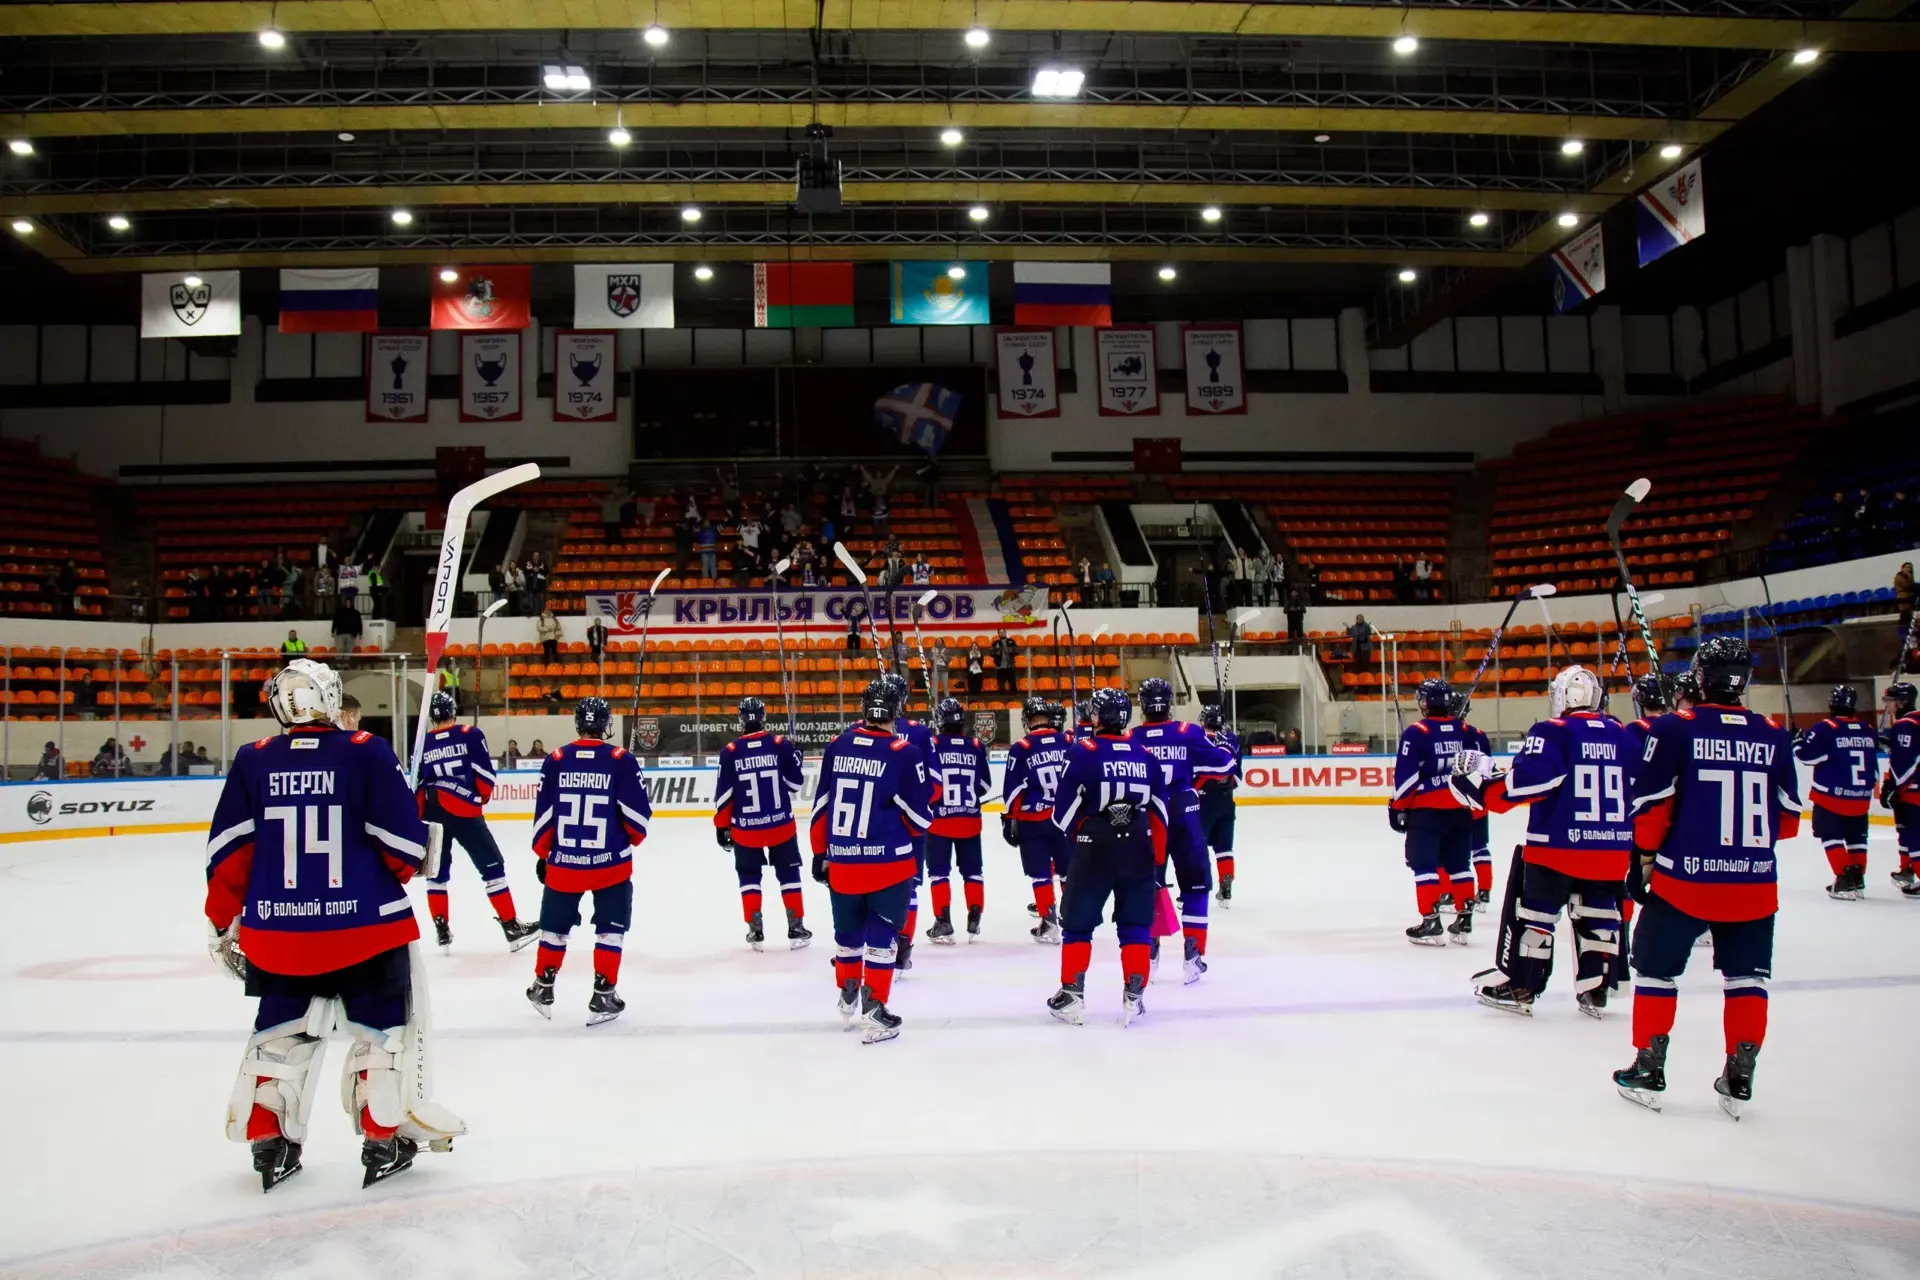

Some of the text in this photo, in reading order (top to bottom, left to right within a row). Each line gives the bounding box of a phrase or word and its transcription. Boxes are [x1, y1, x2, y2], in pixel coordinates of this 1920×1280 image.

[609, 275, 639, 286] МХЛ
[472, 391, 509, 403] 1957
[567, 391, 603, 403] 1974
[1011, 388, 1046, 400] 1974
[1110, 386, 1147, 398] 1977
[1197, 385, 1234, 397] 1989
[674, 595, 813, 624] КРЫЛЬЯ
[729, 722, 790, 733] ЧЕОНАТ
[423, 743, 469, 765] SHAMOLIN
[1524, 736, 1545, 755] 99
[1581, 742, 1617, 761] POPOV
[1642, 735, 1659, 763] 8
[1693, 737, 1776, 766] BUSLAYEV
[734, 754, 779, 772] PLATONOV
[832, 755, 887, 779] BURANOV
[939, 752, 977, 766] VASILYEV
[1849, 750, 1866, 786] 2
[1103, 761, 1147, 779] FYSYNA
[1244, 766, 1396, 788] OLIMPB
[269, 770, 335, 796] STEPIN
[558, 771, 612, 790] GUSAROV
[941, 767, 976, 808] 63
[492, 783, 538, 801] ОЛЬШО
[738, 769, 782, 814] 37
[1574, 764, 1625, 822] 99
[58, 799, 156, 815] SOYUZ
[832, 778, 875, 840] 61
[1698, 768, 1771, 849] 78
[557, 793, 610, 850] 25
[1583, 828, 1615, 842] БОЛЬШОЙ
[264, 805, 343, 889] 74
[1703, 857, 1750, 873] БОЛЬШОЙ
[273, 898, 321, 917] БОЛЬШОЙ
[326, 900, 359, 916] СПОРТ
